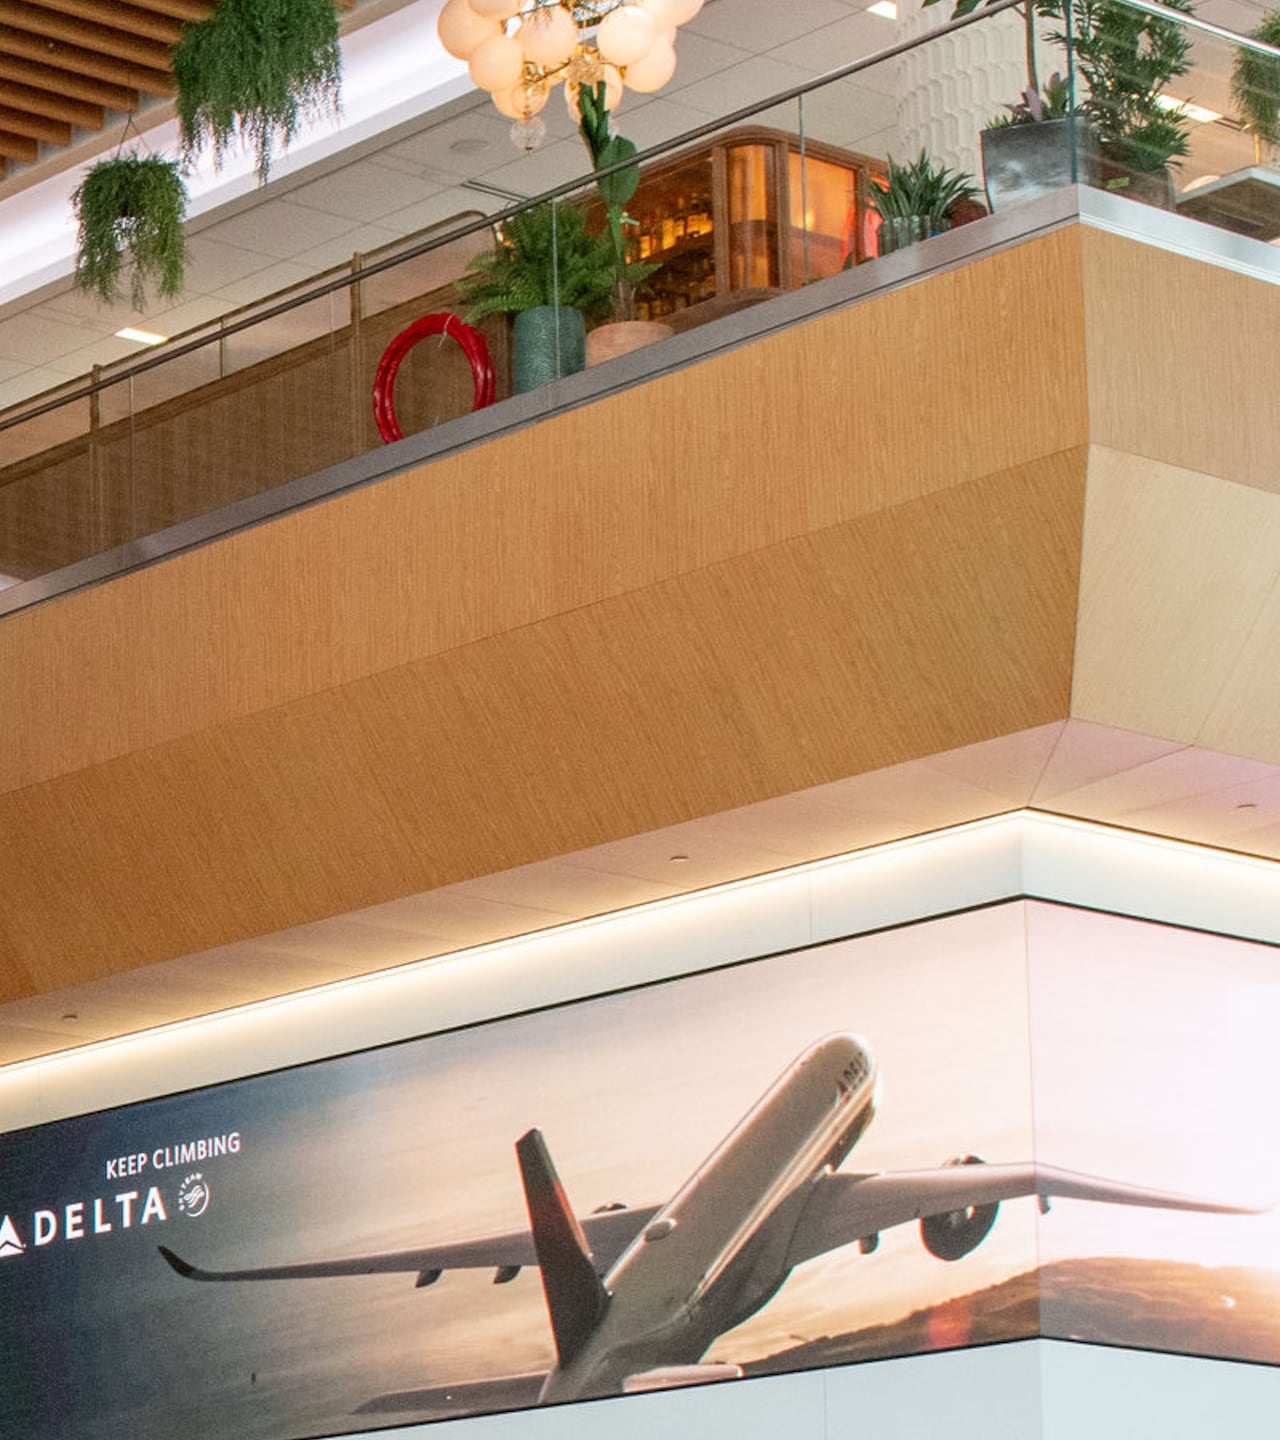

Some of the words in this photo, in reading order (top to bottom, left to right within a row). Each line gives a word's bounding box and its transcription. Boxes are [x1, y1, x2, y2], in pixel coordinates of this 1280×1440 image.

[106, 1152, 148, 1180] KEEP
[152, 1132, 241, 1169] CLIMBING
[33, 1186, 168, 1247] DELTA
